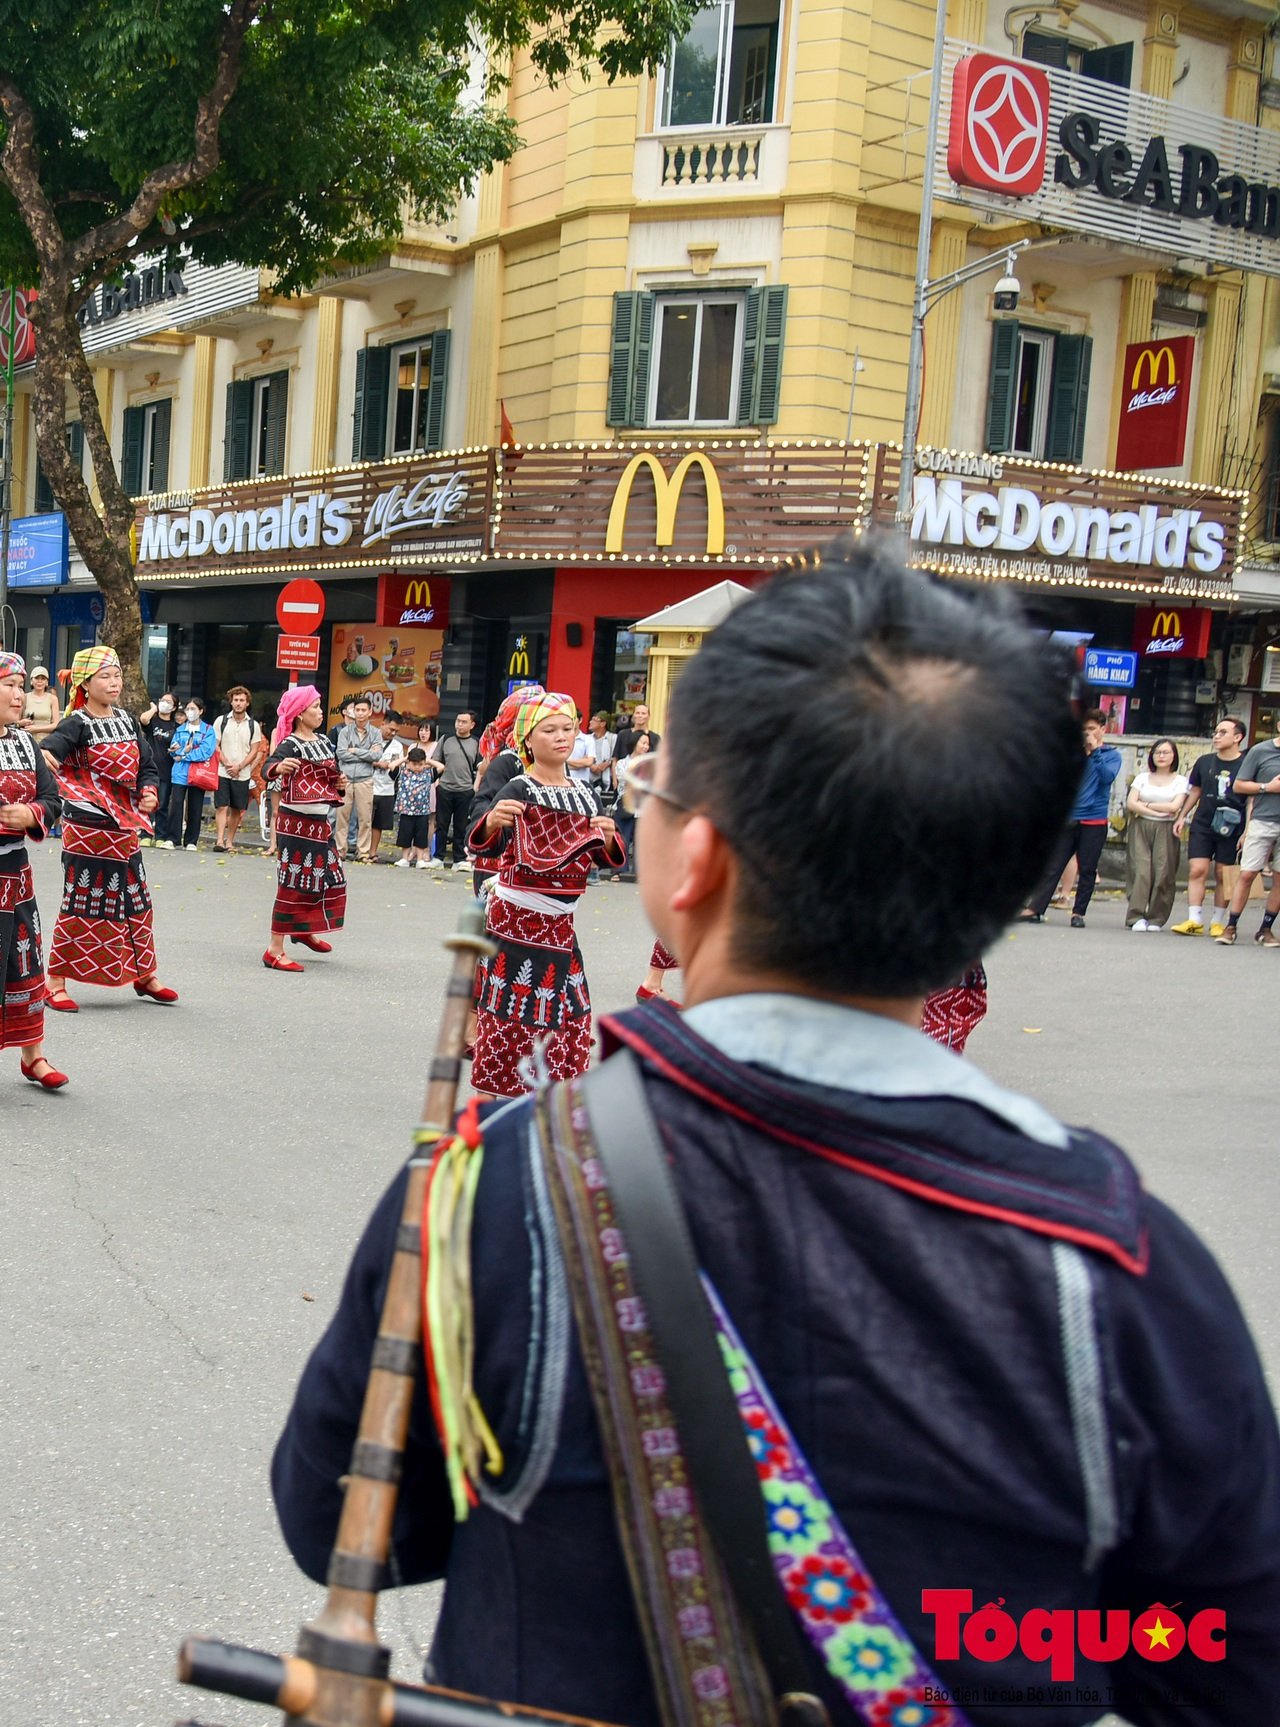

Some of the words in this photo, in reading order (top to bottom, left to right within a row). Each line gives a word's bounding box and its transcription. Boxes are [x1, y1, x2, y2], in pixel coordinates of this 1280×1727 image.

[1054, 112, 1280, 239] SeABan
[138, 493, 353, 561] McDonald's
[363, 470, 469, 540] McCafé
[910, 476, 1226, 572] McDonald's
[1088, 665, 1109, 680] HÀNG
[1110, 667, 1130, 682] KHAY
[1106, 654, 1123, 665] PHỐ
